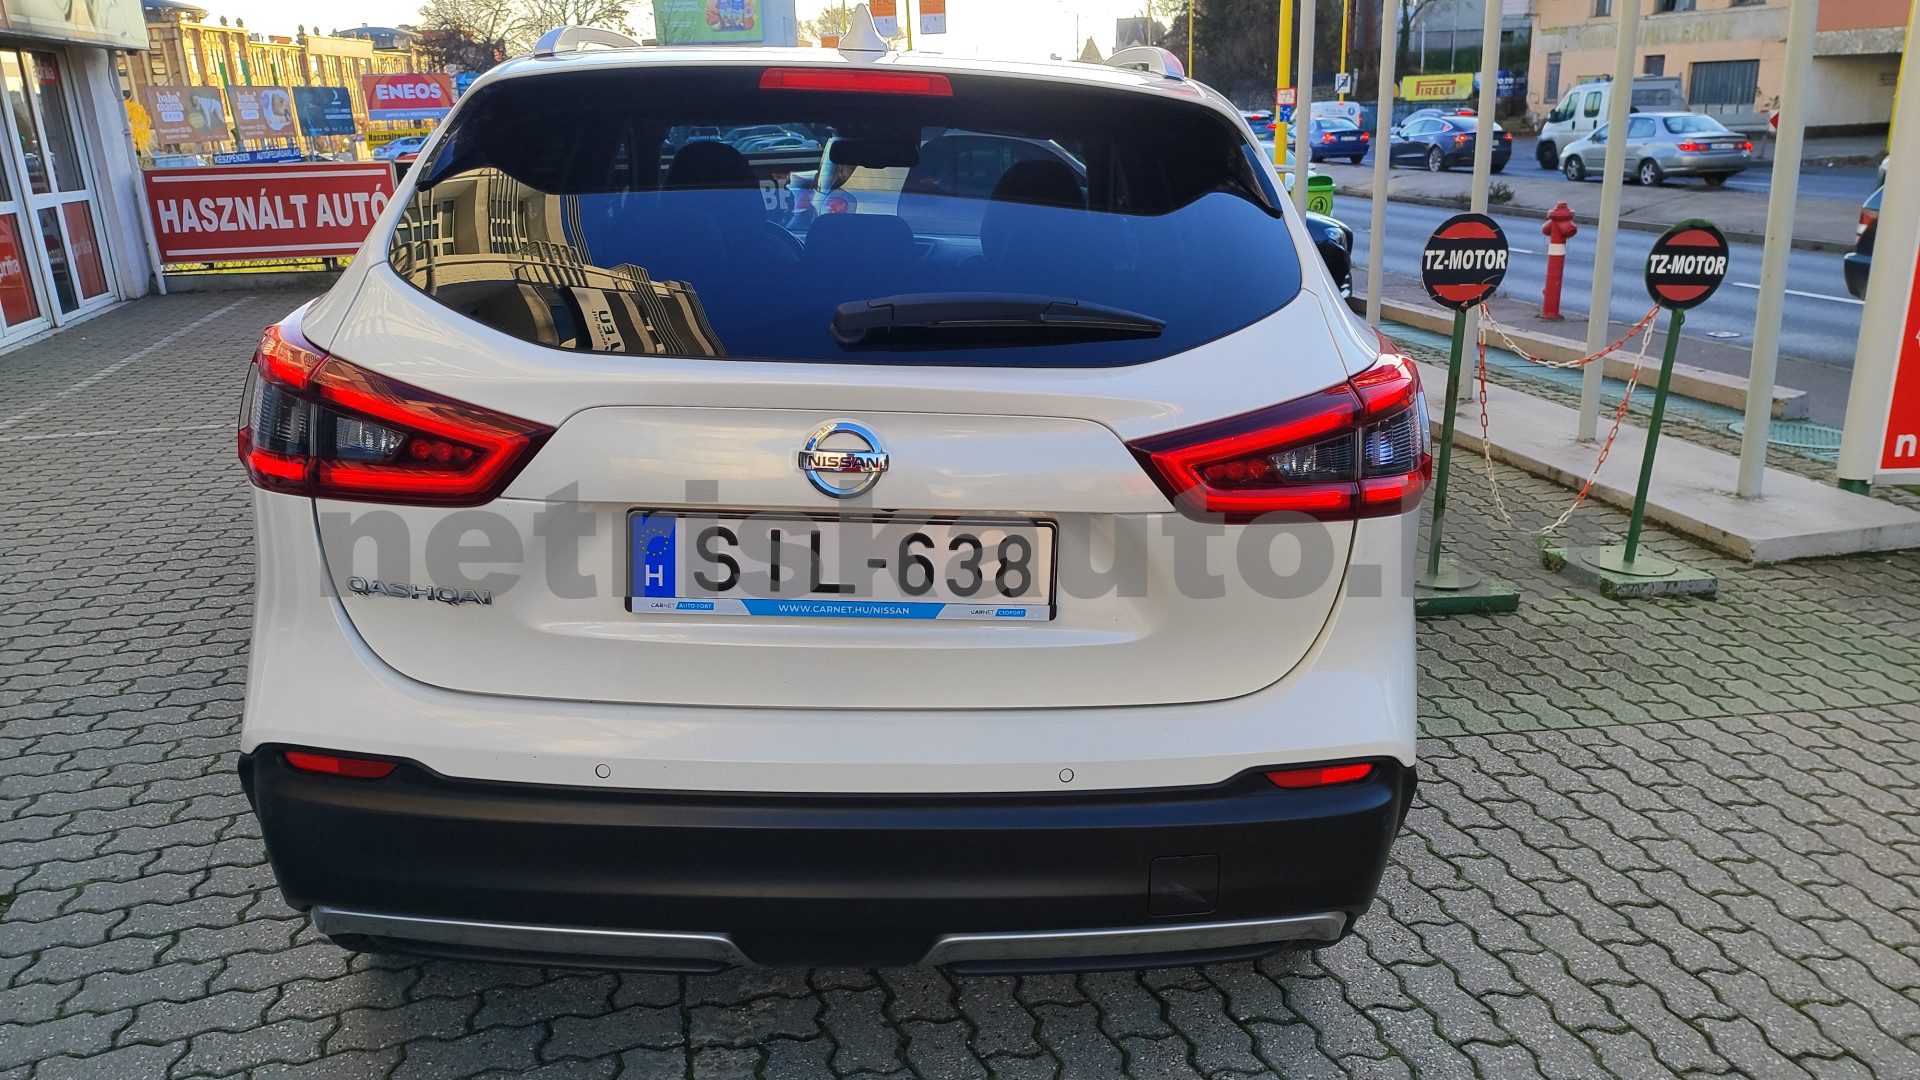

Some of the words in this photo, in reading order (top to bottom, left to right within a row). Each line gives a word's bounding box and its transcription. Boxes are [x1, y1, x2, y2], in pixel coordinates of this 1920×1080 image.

[375, 82, 442, 100] ENEOS
[1415, 79, 1457, 96] PIRELLI
[157, 188, 309, 234] HASZNÁLT
[316, 184, 390, 228] AUTÓ
[1424, 249, 1507, 270] TZ-MOTOR
[1649, 254, 1727, 276] TZ-MOTOR
[808, 455, 879, 469] NISSAN
[693, 526, 1033, 599] SIL-638
[346, 576, 493, 606] QASHQAI
[778, 603, 911, 616] WWW.CARNET.HU/NISSAN
[999, 609, 1024, 617] CSOPORT
